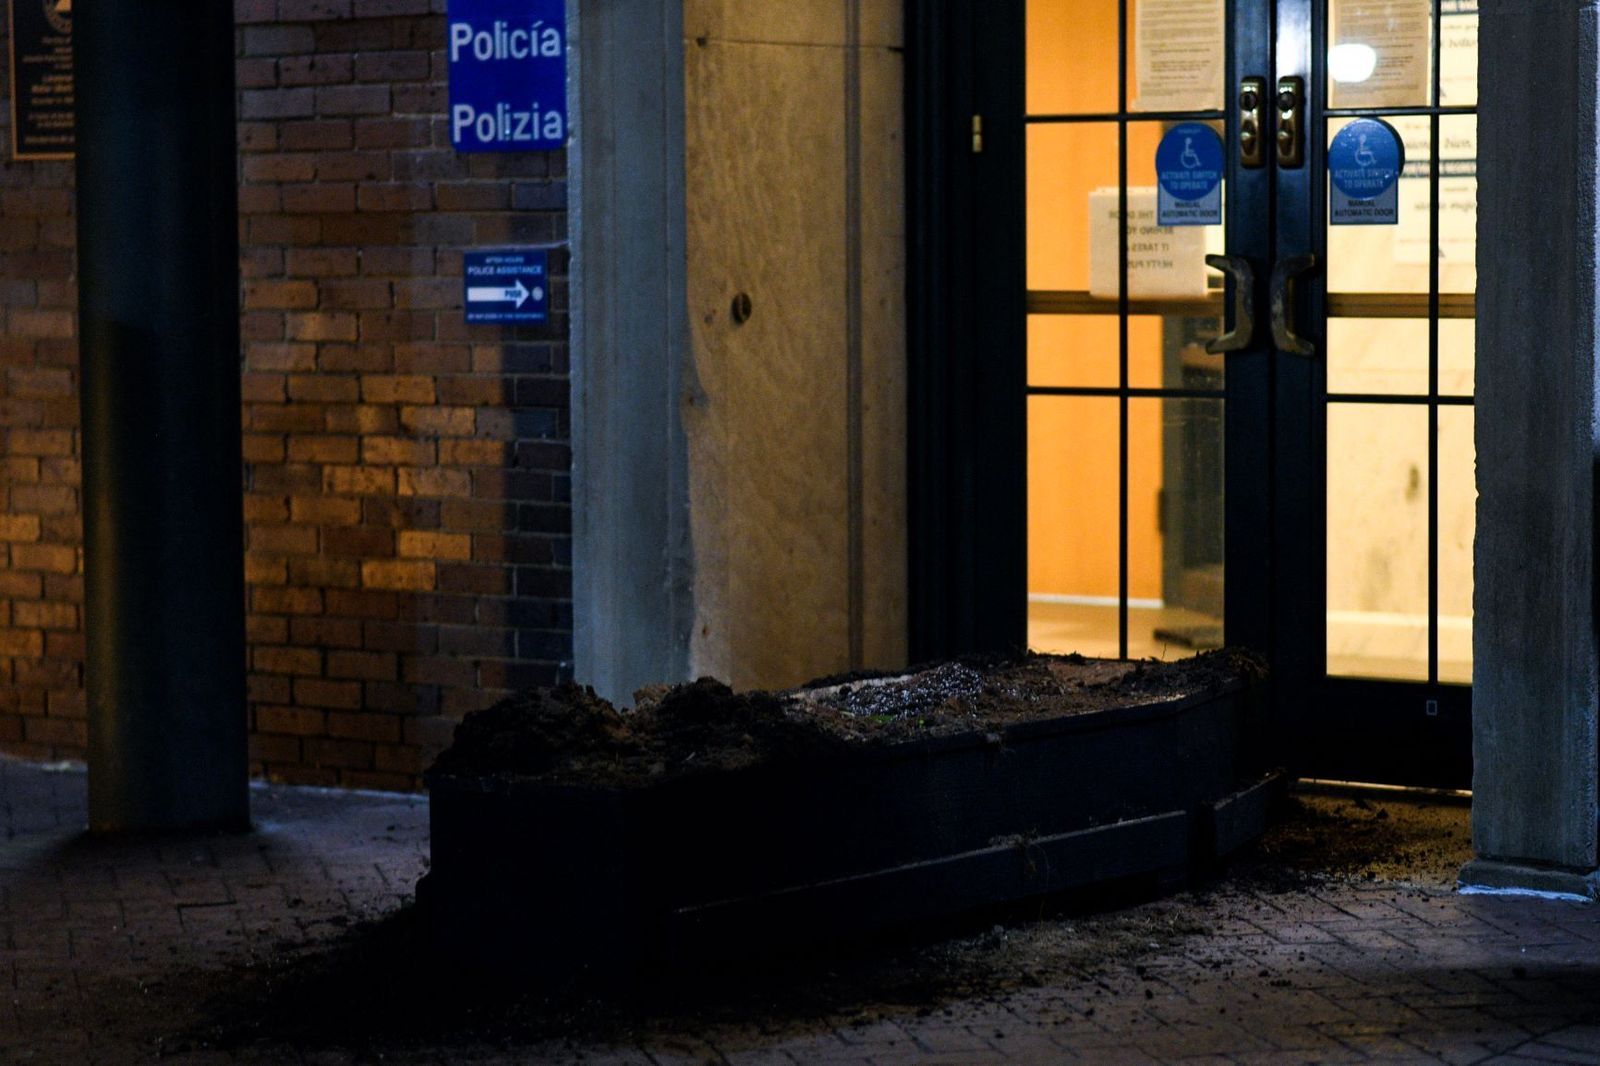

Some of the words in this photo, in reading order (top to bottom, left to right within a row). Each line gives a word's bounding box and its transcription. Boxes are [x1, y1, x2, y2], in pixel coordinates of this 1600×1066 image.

[450, 20, 562, 62] Policía
[453, 102, 563, 143] Polizia
[1161, 209, 1198, 218] AUTOMATIC
[1334, 208, 1372, 217] AUTOMATIC
[467, 265, 494, 275] POLICE
[496, 265, 542, 275] ASSISTANCE
